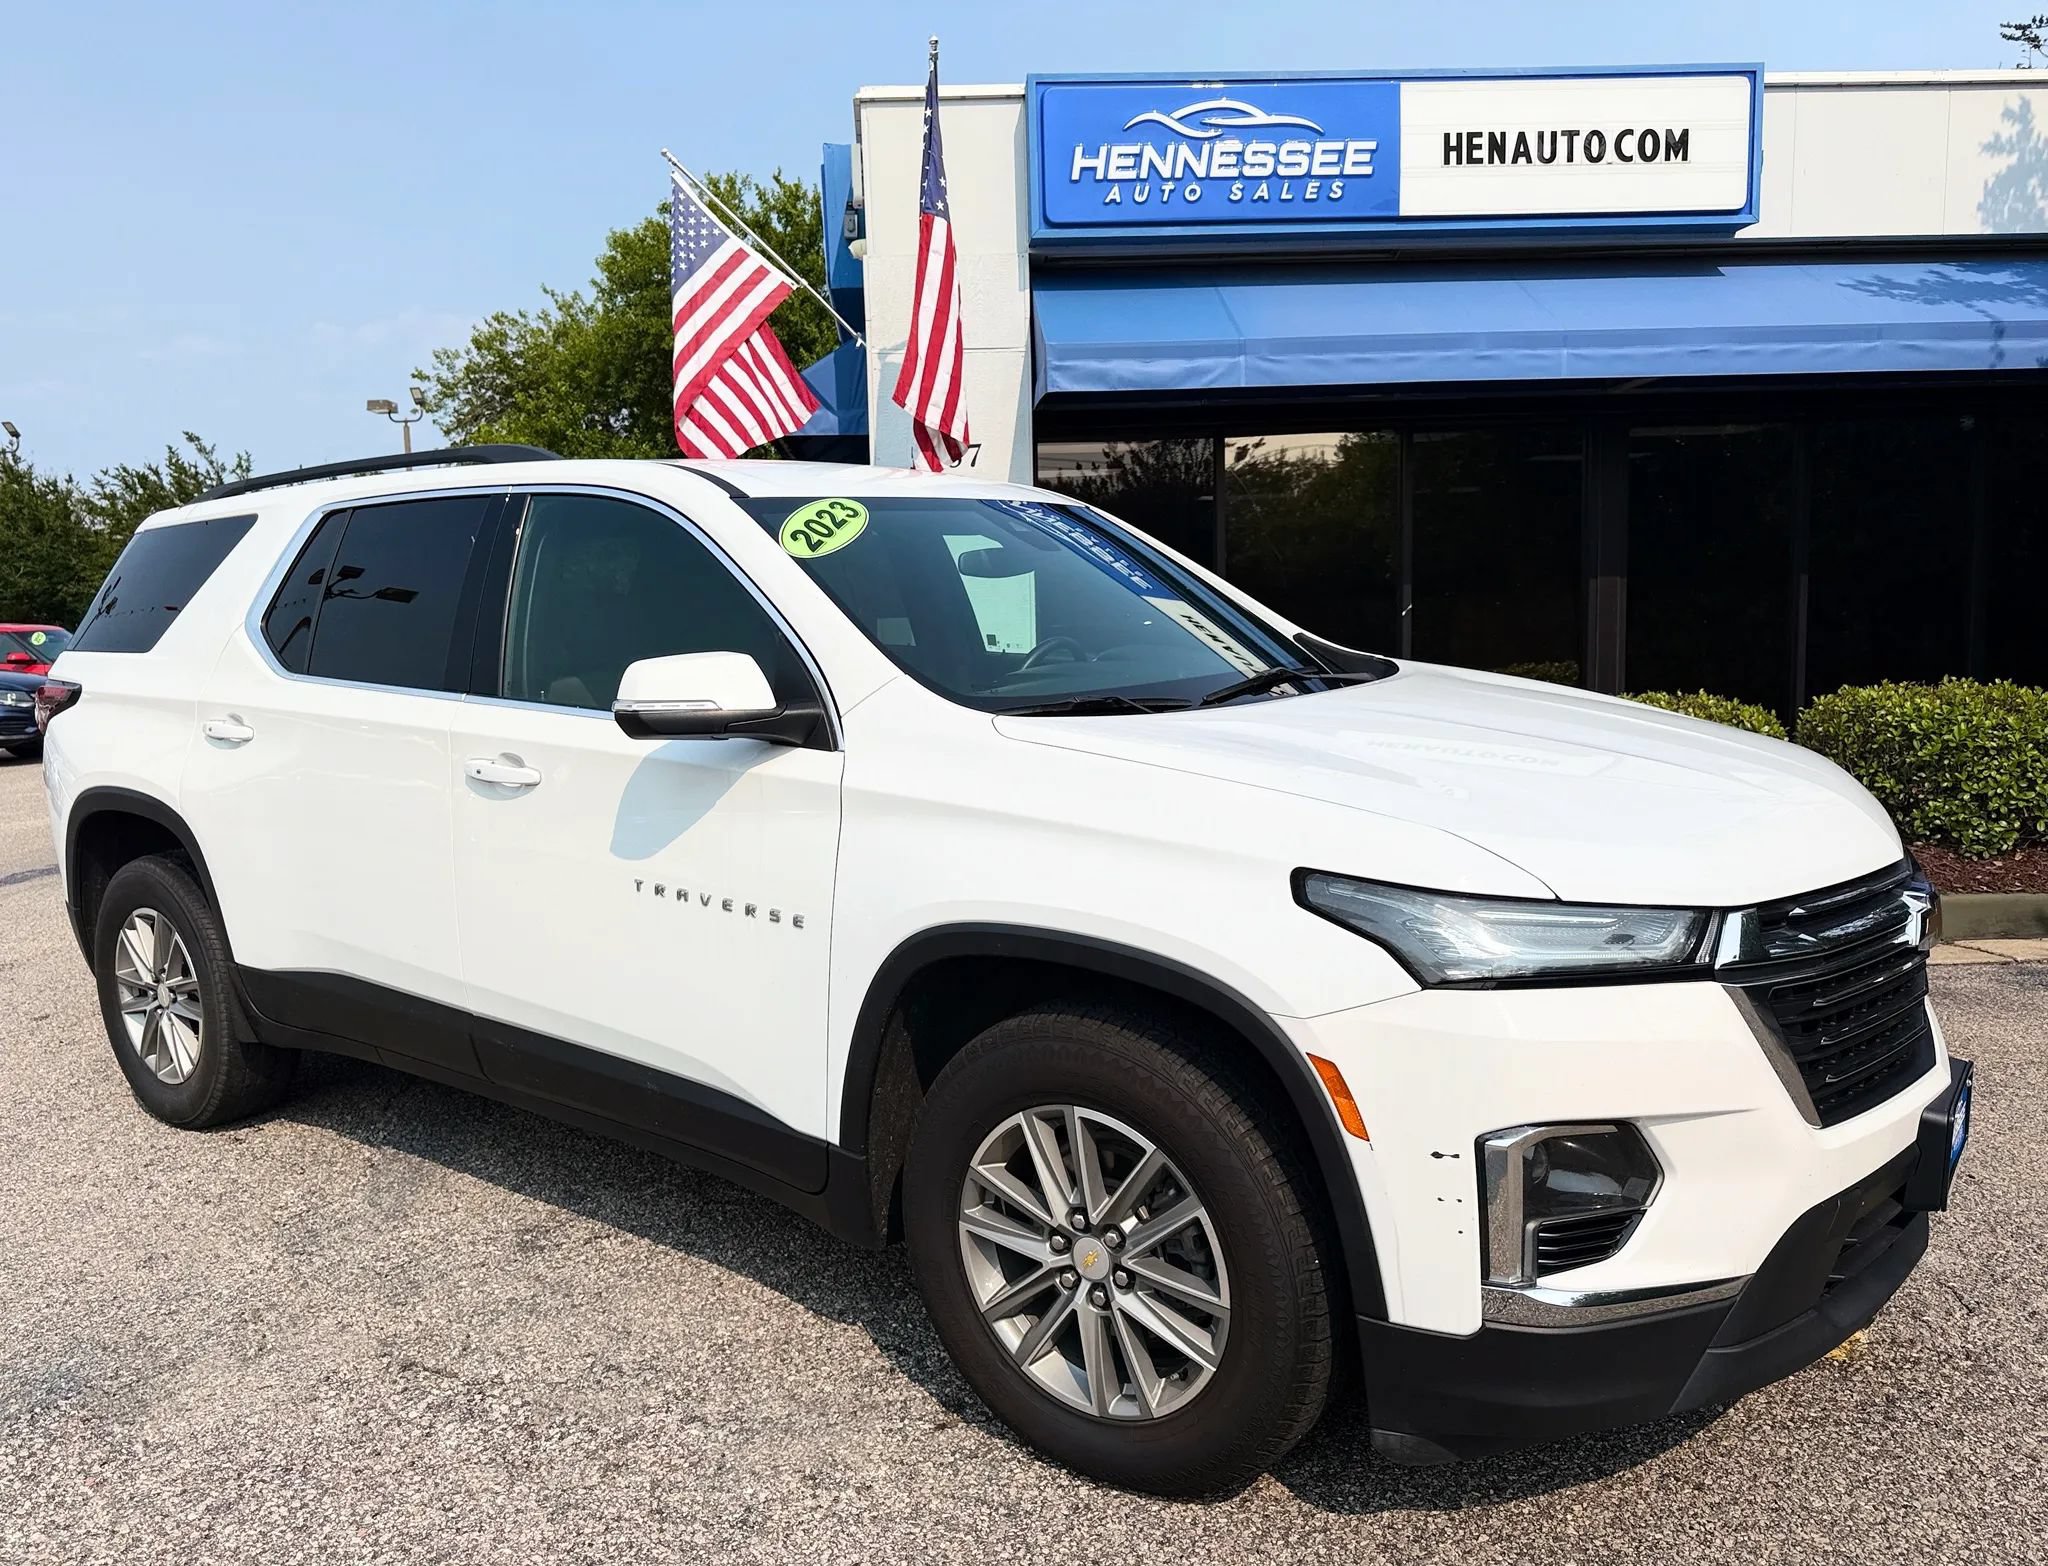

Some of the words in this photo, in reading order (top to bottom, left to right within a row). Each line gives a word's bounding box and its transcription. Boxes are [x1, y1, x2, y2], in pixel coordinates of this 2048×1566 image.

[1070, 138, 1378, 181] HENNESSEE
[1442, 128, 1690, 165] HENAUTO.COM
[1104, 182, 1203, 205] AUTO
[1228, 180, 1345, 202] SALES
[790, 501, 860, 553] 2023
[633, 878, 806, 929] TRAVERSE
